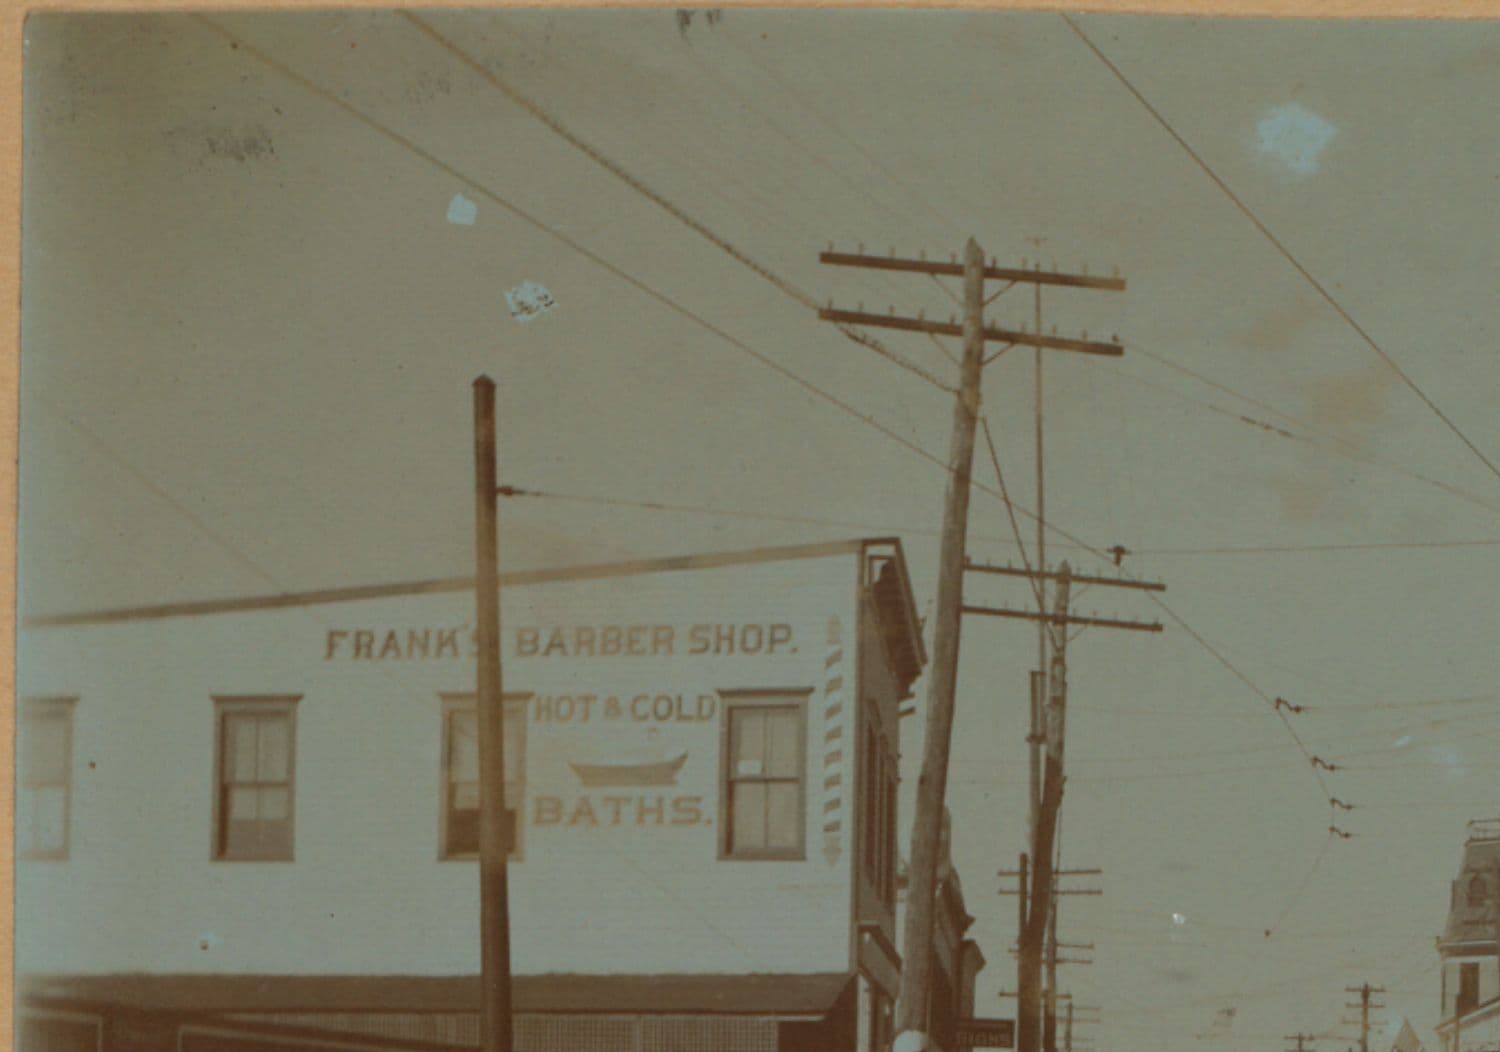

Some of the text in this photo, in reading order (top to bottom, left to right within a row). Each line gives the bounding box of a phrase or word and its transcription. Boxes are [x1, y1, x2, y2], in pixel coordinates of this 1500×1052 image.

[323, 622, 800, 661] FRANK' BARBER SHOP.
[533, 693, 717, 723] HOT & COLD
[532, 796, 714, 826] BATHS.
